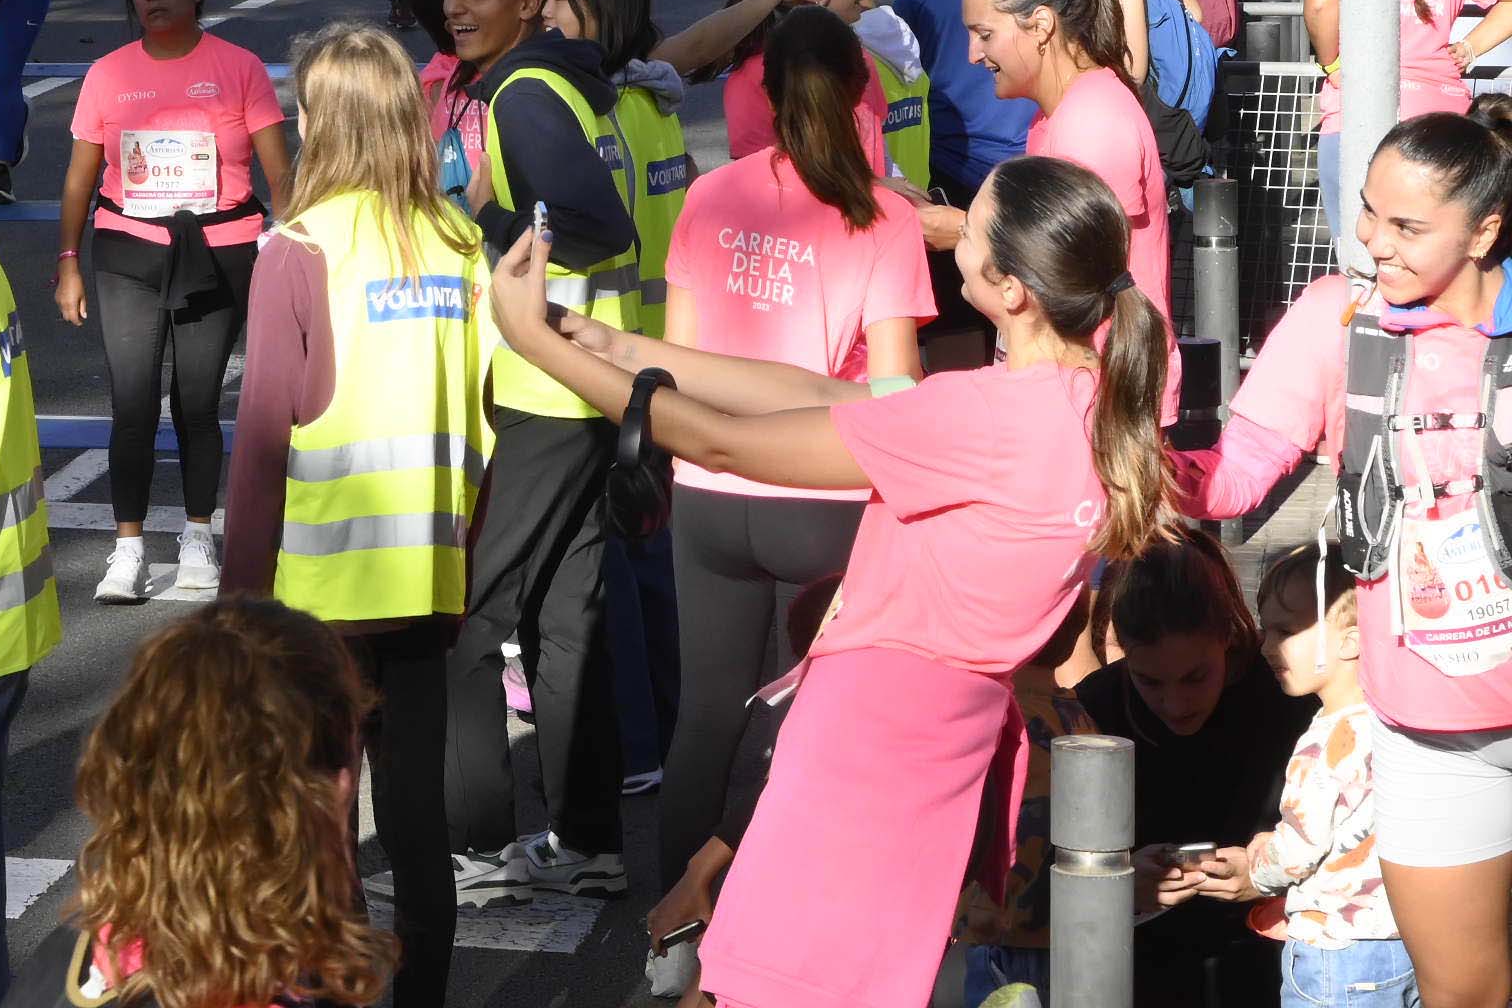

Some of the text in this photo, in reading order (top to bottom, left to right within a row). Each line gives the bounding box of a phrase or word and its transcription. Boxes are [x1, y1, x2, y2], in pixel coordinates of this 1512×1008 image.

[151, 165, 183, 177] 016
[717, 226, 816, 268] CARRERA
[731, 251, 793, 282] DE LA
[368, 286, 464, 313] VOLUNTA
[724, 273, 795, 306] MUJER
[1467, 597, 1511, 621] 19057
[1424, 621, 1506, 642] CARRERA DE LA
